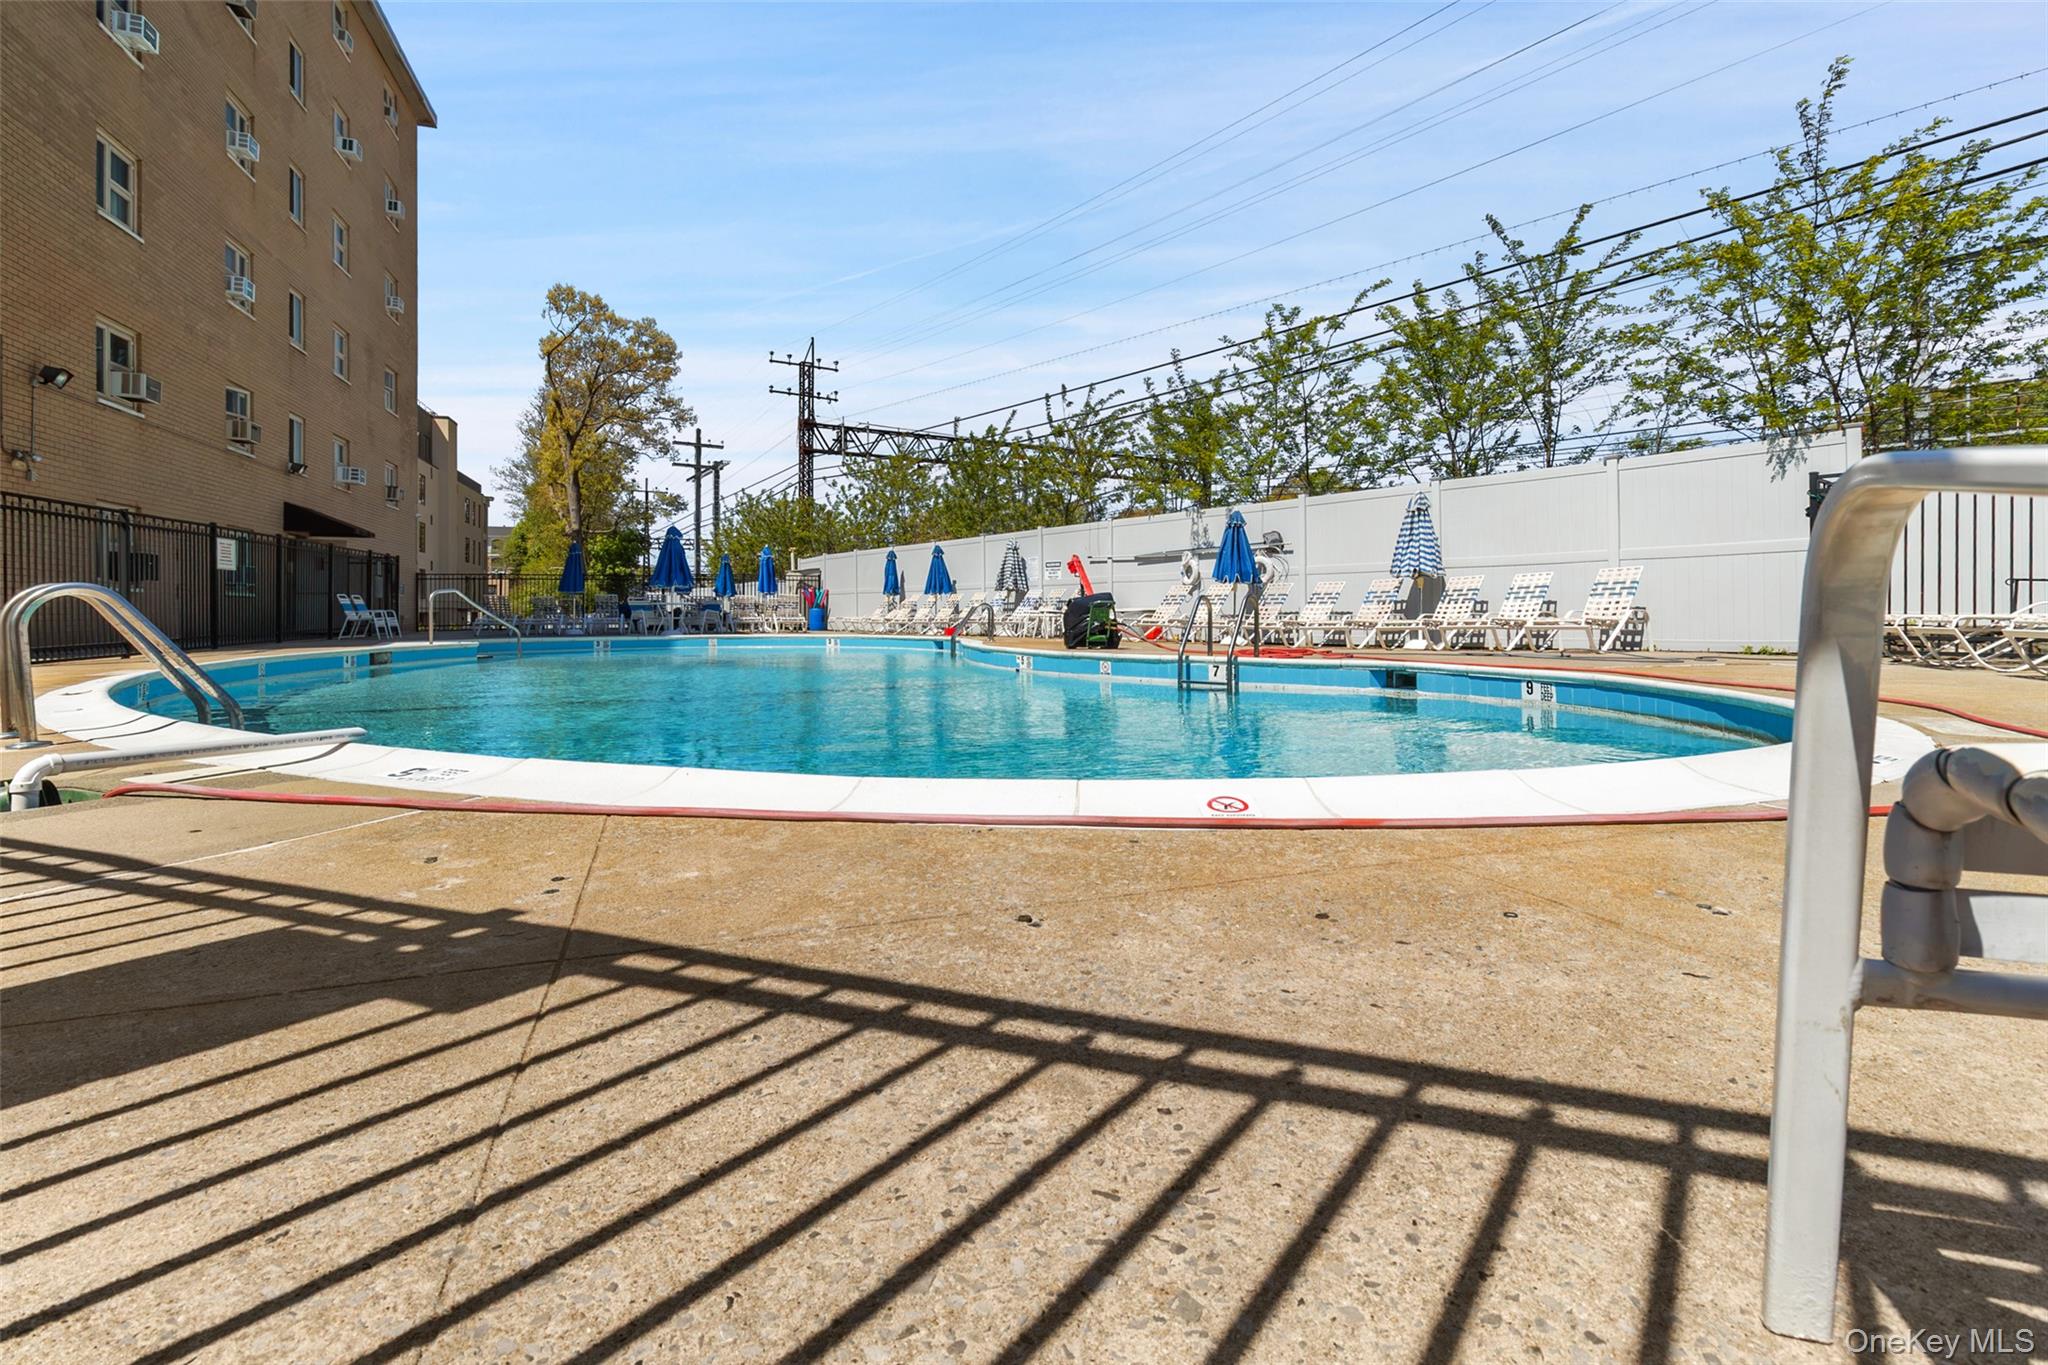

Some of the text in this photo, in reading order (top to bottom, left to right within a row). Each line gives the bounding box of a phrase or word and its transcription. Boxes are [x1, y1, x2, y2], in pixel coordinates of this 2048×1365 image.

[1212, 664, 1220, 677] 7
[1526, 680, 1534, 695] 9
[1540, 682, 1553, 692] FEET
[1540, 691, 1553, 702] DEEP
